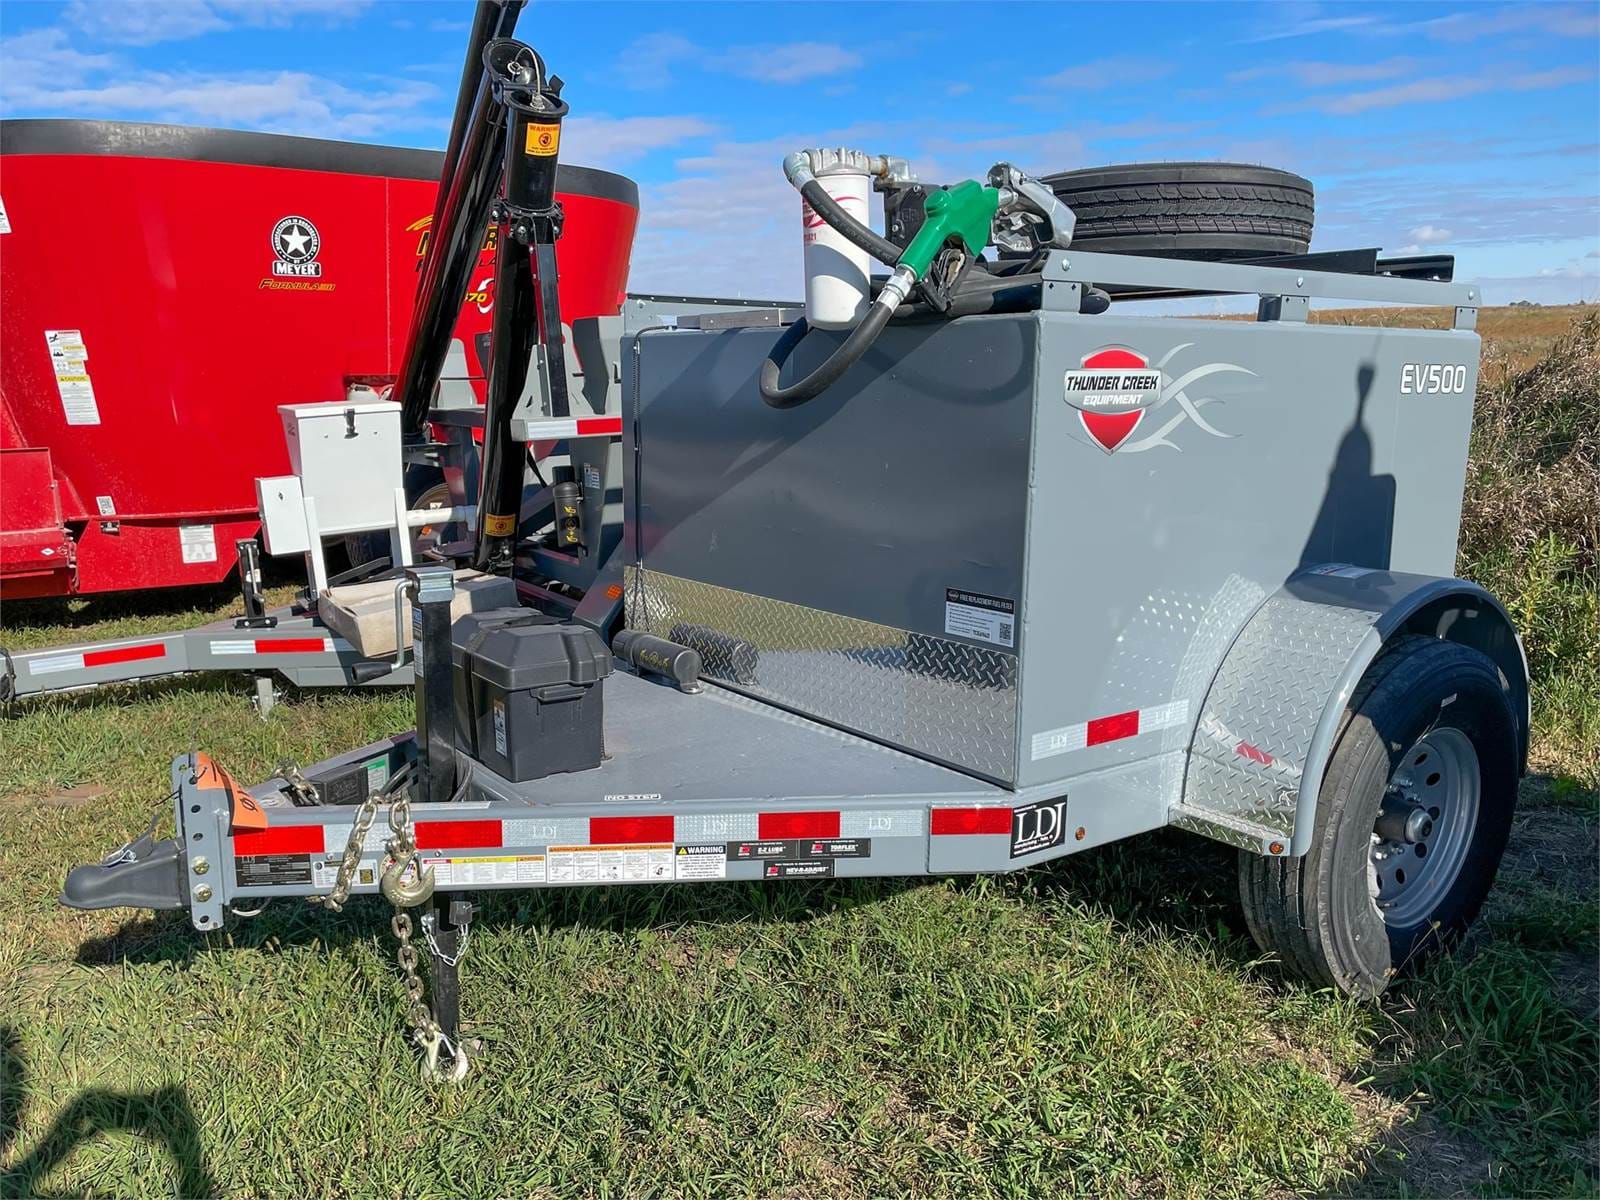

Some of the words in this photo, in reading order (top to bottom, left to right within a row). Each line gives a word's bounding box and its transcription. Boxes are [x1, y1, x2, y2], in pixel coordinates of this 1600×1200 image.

[276, 262, 316, 275] MEYER
[1066, 375, 1121, 391] THUNDER
[1121, 375, 1159, 390] CREEK
[1400, 363, 1467, 394] EV500
[1083, 394, 1143, 406] EQUIPMENT
[1015, 802, 1066, 844] LDJ
[687, 846, 724, 854] WARNING
